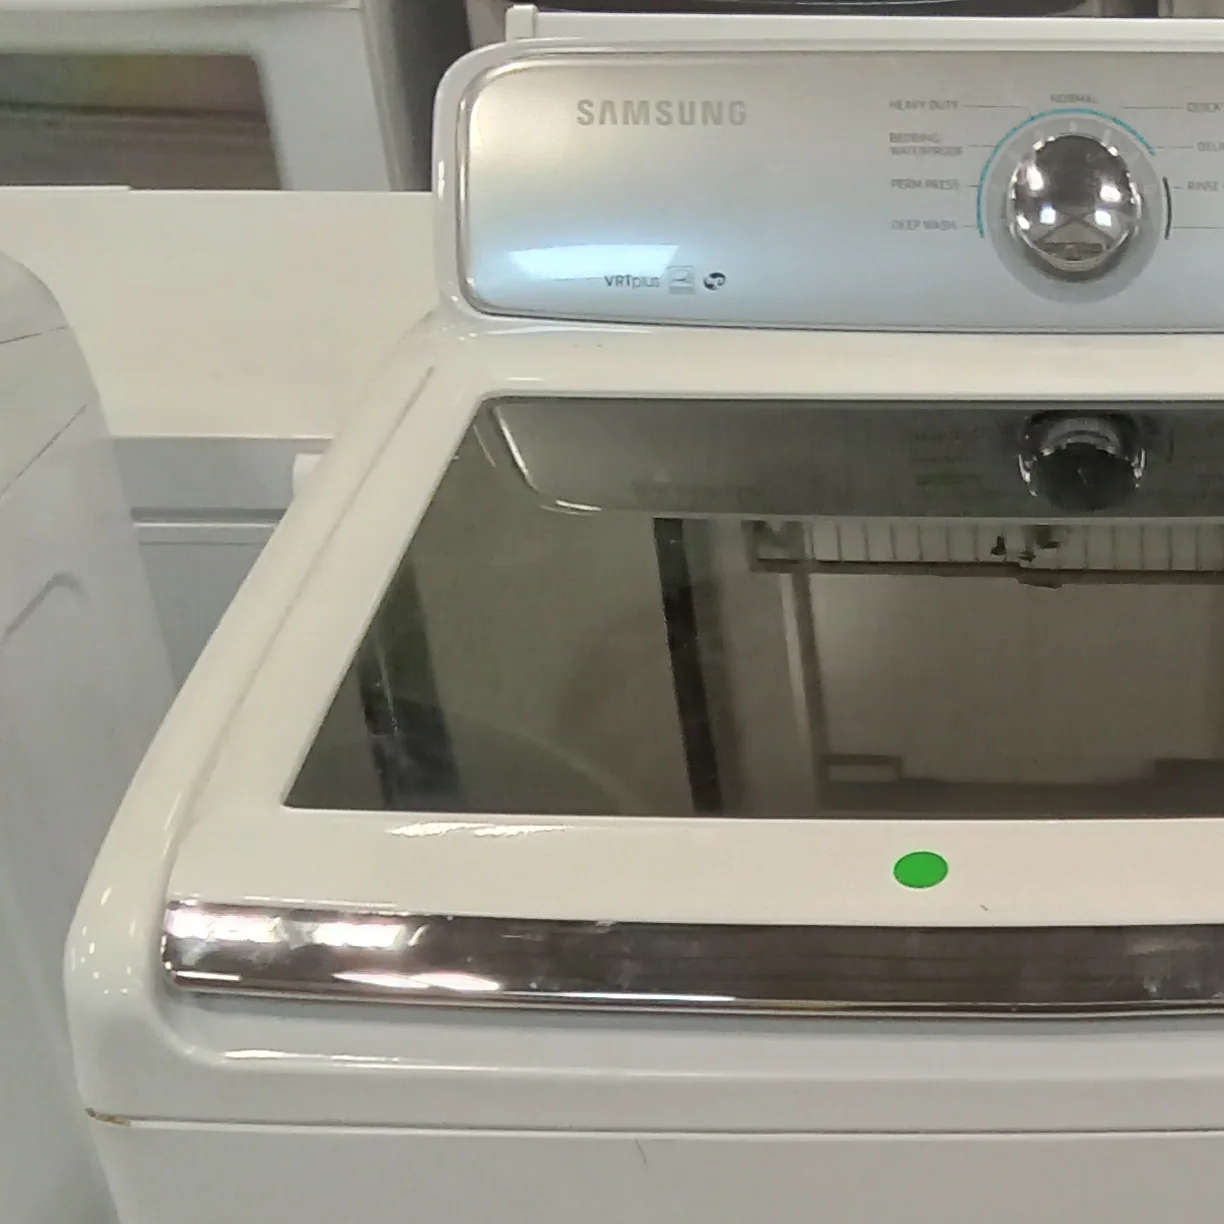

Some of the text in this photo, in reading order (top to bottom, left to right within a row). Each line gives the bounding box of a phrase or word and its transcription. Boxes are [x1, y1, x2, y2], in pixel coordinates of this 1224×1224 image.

[576, 98, 748, 126] SAMSUNG
[889, 99, 960, 110] HEAVY DUTY
